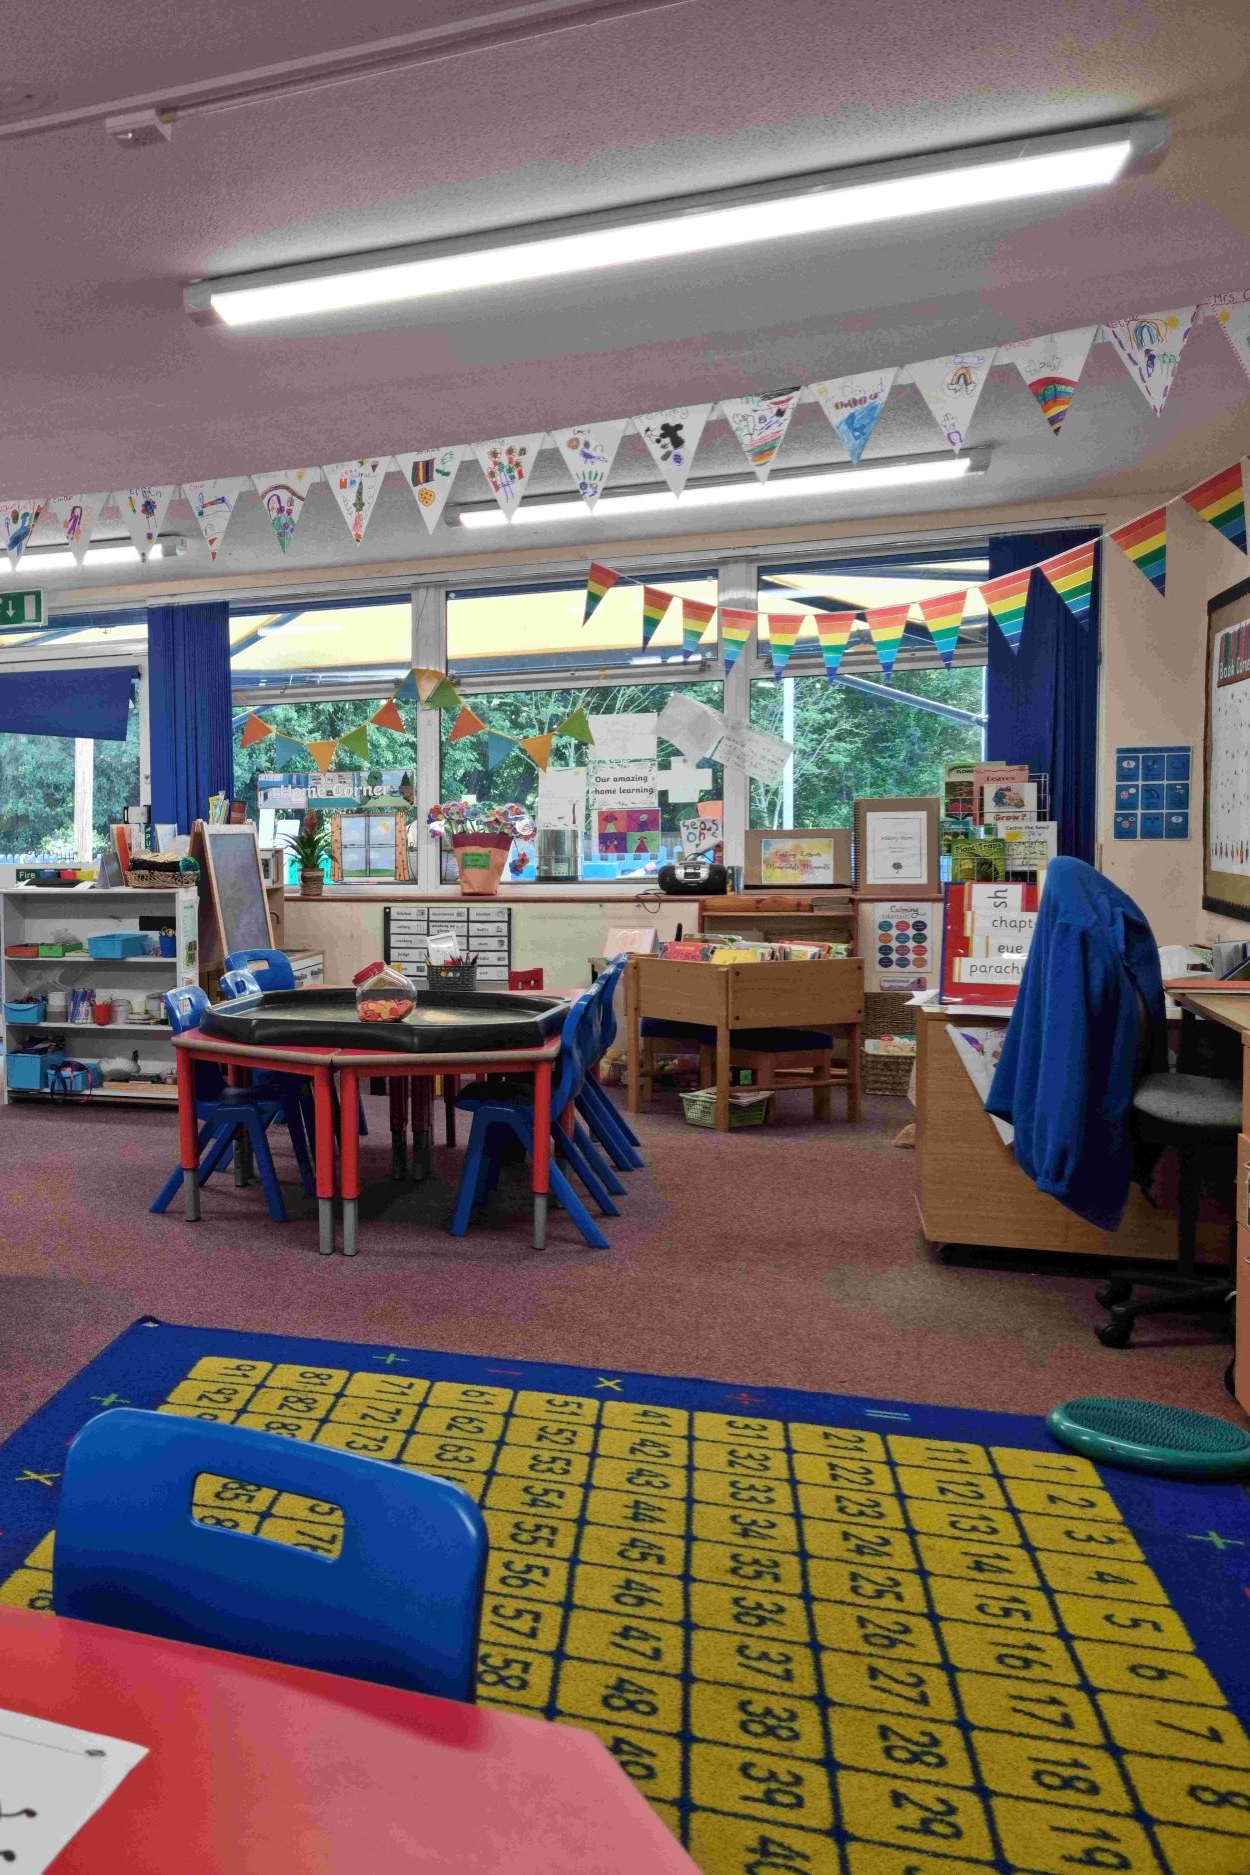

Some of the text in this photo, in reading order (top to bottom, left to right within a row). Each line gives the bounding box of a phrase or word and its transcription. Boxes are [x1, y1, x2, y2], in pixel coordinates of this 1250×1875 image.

[613, 775, 648, 783] amazing
[280, 784, 391, 800] Home Corner
[619, 787, 654, 796] learning
[994, 813, 1027, 821] Grow?
[955, 842, 1003, 854] Plant Traps
[19, 871, 36, 879] Fire
[987, 888, 1008, 908] sh
[992, 916, 1034, 932] chapt
[970, 962, 1024, 976] parach
[223, 1364, 256, 1380] 91
[299, 1370, 333, 1389] 81
[197, 1386, 240, 1405] 92
[374, 1379, 414, 1397] 71
[461, 1389, 490, 1408] 61
[277, 1395, 319, 1414] 82
[360, 1405, 403, 1426] 72
[546, 1398, 584, 1417] 51
[450, 1414, 484, 1435] 62
[639, 1410, 673, 1429] 41
[726, 1420, 769, 1441] 31
[350, 1431, 393, 1454] 73
[545, 1425, 579, 1447] 52
[823, 1430, 866, 1454] 21
[434, 1443, 476, 1464] 63
[629, 1437, 671, 1460] 42
[924, 1446, 972, 1466] 11
[528, 1453, 572, 1476] 53
[726, 1449, 772, 1473] 32
[1034, 1463, 1078, 1473] 1
[625, 1467, 670, 1490] 43
[828, 1462, 874, 1487] 22
[522, 1485, 567, 1509] 54
[729, 1479, 776, 1506] 33
[936, 1479, 986, 1502] 12
[1047, 1493, 1097, 1510] 2
[623, 1500, 667, 1524] 44
[835, 1494, 887, 1521] 23
[510, 1520, 559, 1549] 55
[730, 1514, 778, 1541] 34
[949, 1513, 999, 1538] 13
[1064, 1529, 1116, 1546] 3
[617, 1537, 667, 1566] 45
[841, 1530, 893, 1558] 24
[730, 1552, 782, 1584] 35
[960, 1551, 1015, 1575] 14
[500, 1560, 550, 1591] 56
[849, 1570, 903, 1603] 25
[1086, 1569, 1139, 1586] 4
[612, 1578, 663, 1607] 46
[733, 1596, 787, 1629] 36
[974, 1593, 1032, 1622] 15
[490, 1603, 543, 1640] 57
[856, 1615, 916, 1649] 26
[1103, 1613, 1165, 1633] 5
[609, 1624, 663, 1662] 47
[736, 1644, 794, 1683] 37
[989, 1642, 1053, 1671] 16
[476, 1652, 534, 1691] 58
[1126, 1663, 1189, 1682] 6
[601, 1676, 659, 1717] 48
[867, 1664, 930, 1707] 27
[737, 1699, 799, 1742] 38
[1007, 1694, 1077, 1731] 17
[1155, 1720, 1224, 1744] 7
[878, 1724, 947, 1769] 28
[738, 1761, 806, 1811] 39
[1027, 1757, 1102, 1797] 18
[889, 1789, 964, 1841] 29
[1049, 1825, 1132, 1871] 19
